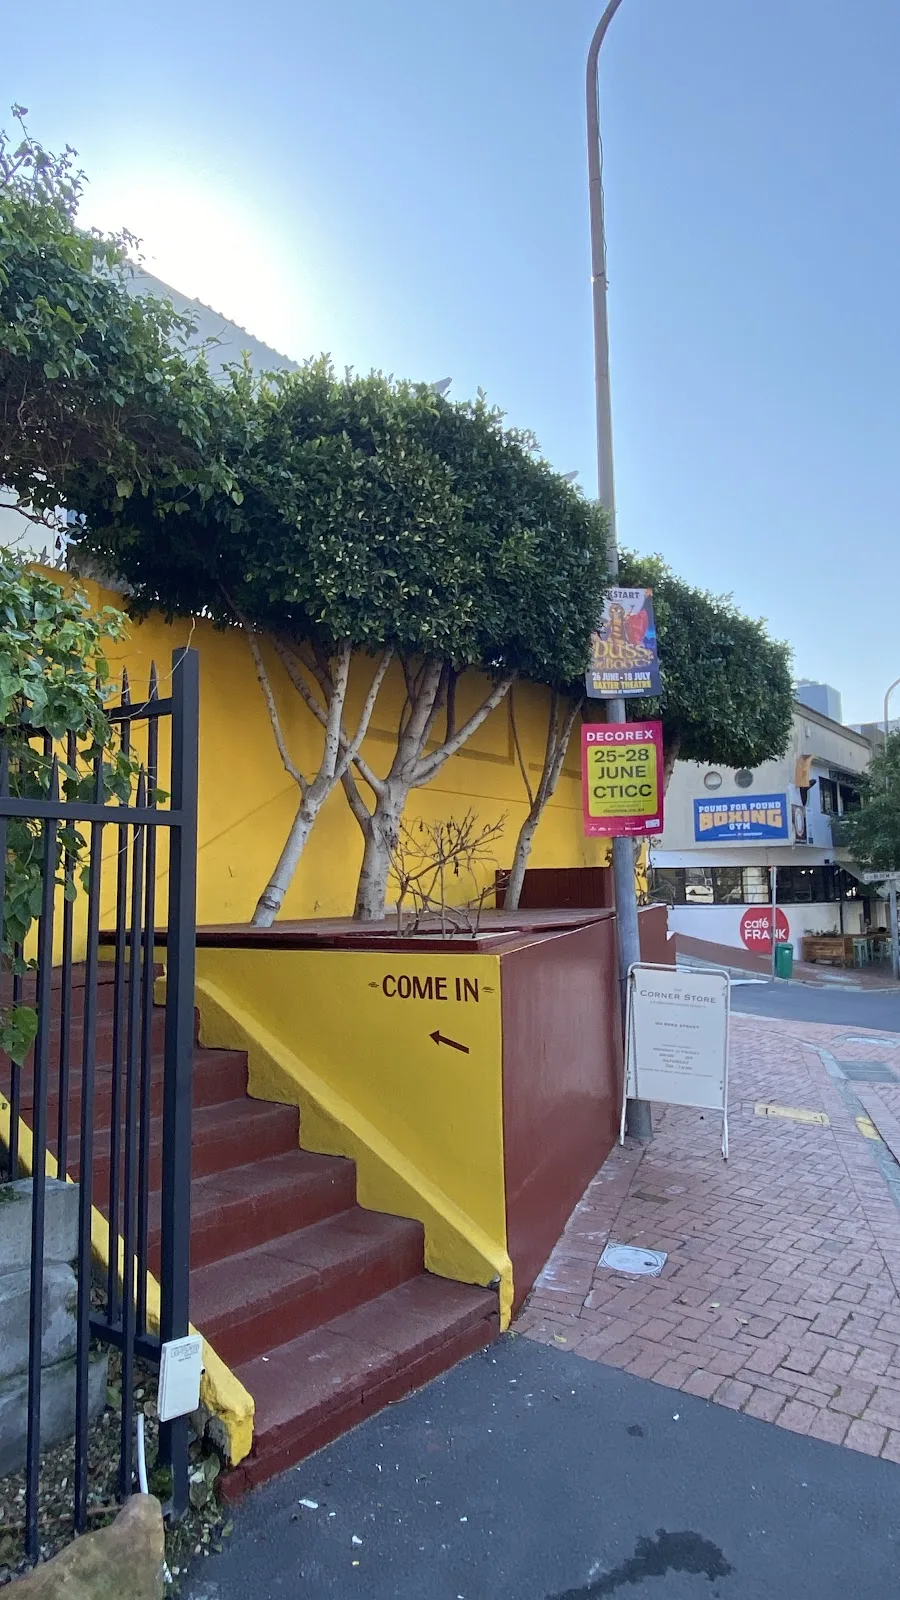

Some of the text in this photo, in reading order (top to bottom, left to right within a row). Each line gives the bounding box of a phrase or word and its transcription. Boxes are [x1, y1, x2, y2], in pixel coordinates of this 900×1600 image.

[602, 672, 619, 681] JUNE
[634, 671, 651, 681] JULY
[593, 680, 652, 690] BAXTER THEATRE
[586, 730, 653, 742] DECOREX
[594, 749, 649, 763] 25-28
[598, 766, 646, 780] JUNE
[593, 784, 652, 798] CTICC
[698, 801, 781, 813] POUND FOR POUND
[699, 809, 782, 832] BOXING
[729, 822, 751, 830] GYM
[744, 917, 769, 929] café
[745, 928, 787, 940] FRANK
[382, 974, 479, 1003] COME IN
[640, 989, 680, 1000] CORNER
[684, 994, 717, 1004] STORE
